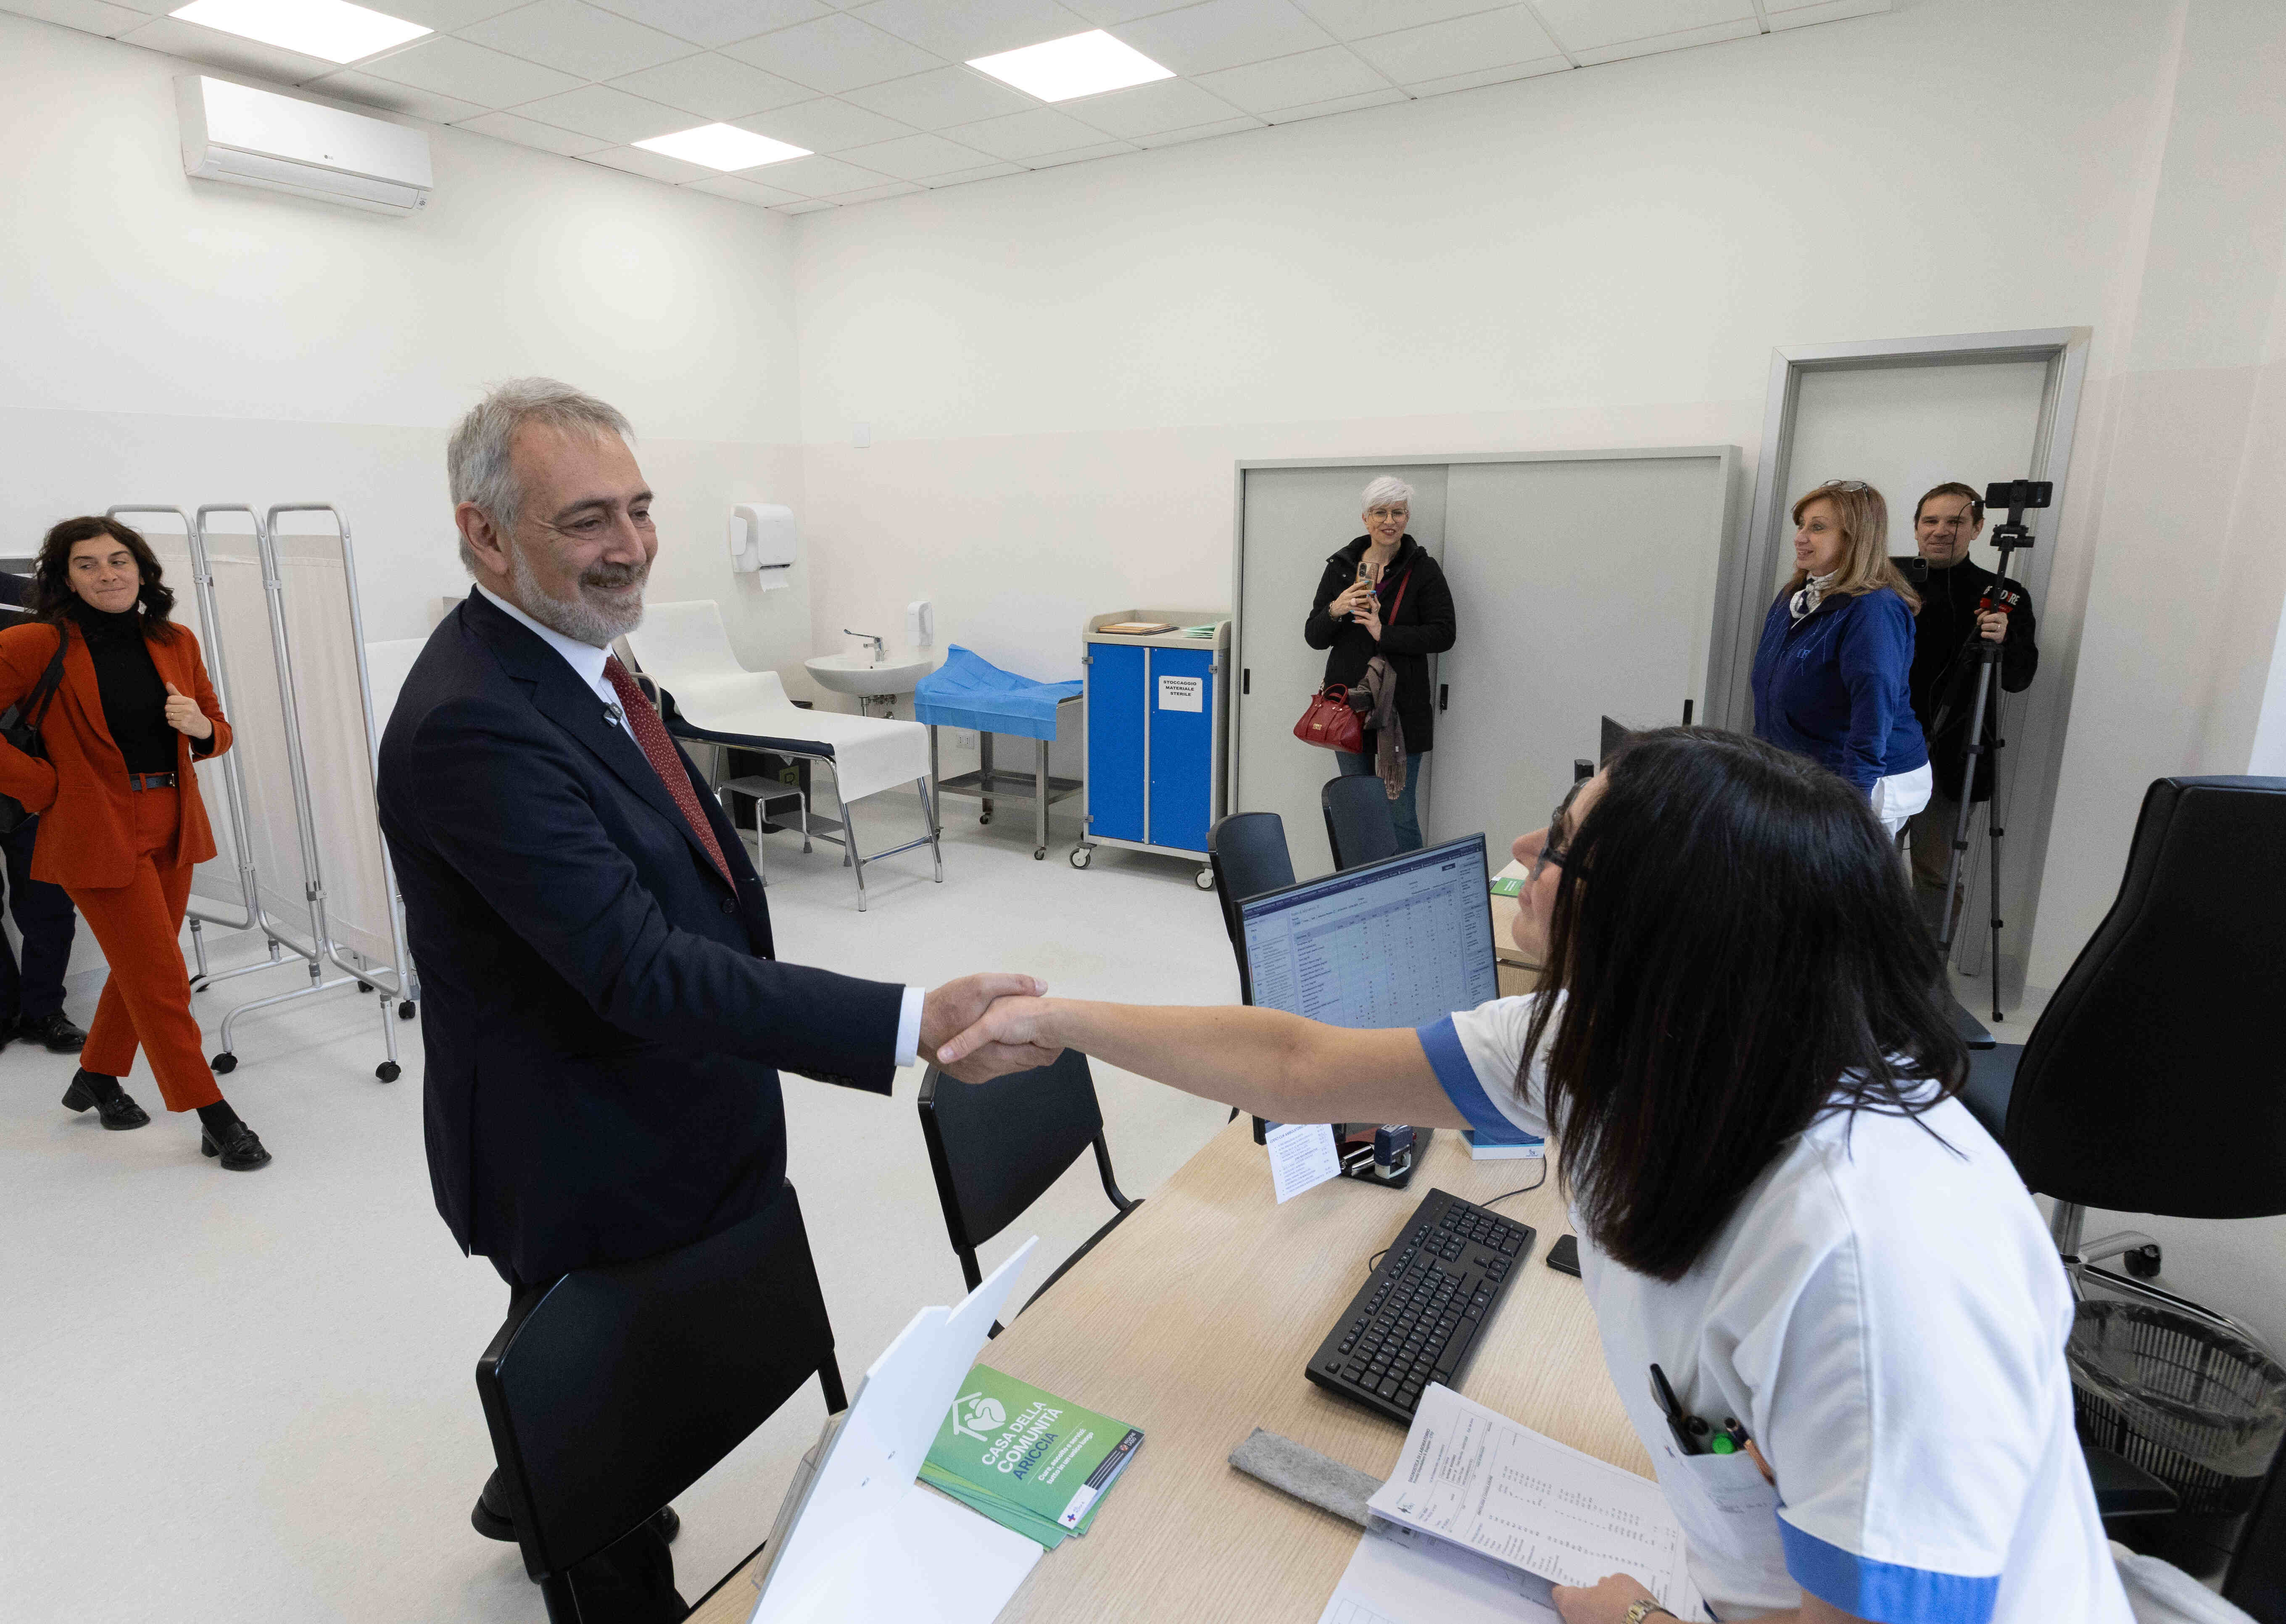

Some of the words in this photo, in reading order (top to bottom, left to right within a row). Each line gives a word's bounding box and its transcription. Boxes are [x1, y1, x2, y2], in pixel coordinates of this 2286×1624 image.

[982, 1433, 1016, 1465] CASA
[1009, 1402, 1046, 1433] DELLA
[997, 1408, 1063, 1473] COMUNITÀ
[1013, 1433, 1059, 1481] ARICCIA
[1039, 1466, 1055, 1481] Cure,
[1051, 1448, 1068, 1466] ascolto
[1070, 1428, 1086, 1444] servizi:
[1047, 1470, 1060, 1484] tutto
[1068, 1445, 1083, 1458] unico
[1079, 1432, 1094, 1445] luogo
